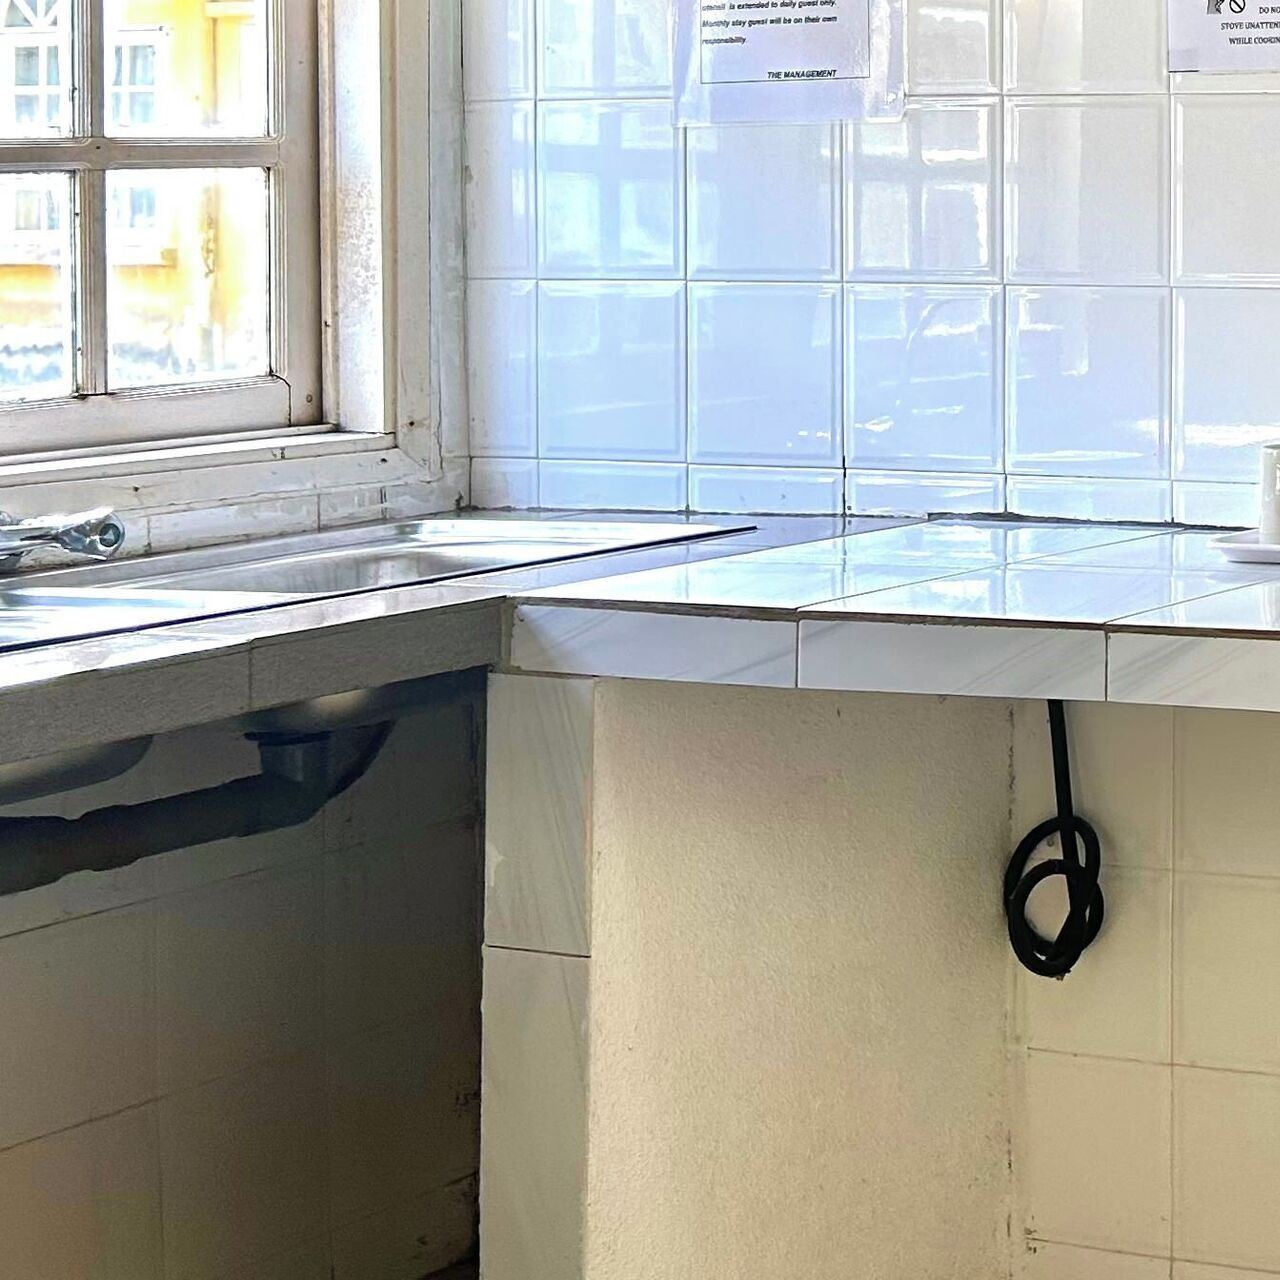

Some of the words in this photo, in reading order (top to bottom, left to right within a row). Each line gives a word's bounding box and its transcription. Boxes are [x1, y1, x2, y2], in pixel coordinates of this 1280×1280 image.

[737, 1, 769, 9] extended
[780, 0, 796, 8] daily
[798, 0, 818, 8] guest
[1259, 6, 1269, 14] DO
[731, 19, 746, 28] stay
[748, 18, 768, 27] guest
[1220, 22, 1244, 30] STOVE
[1228, 37, 1252, 45] WHILE
[767, 71, 782, 79] THE
[784, 69, 837, 78] MANAGEMENT
